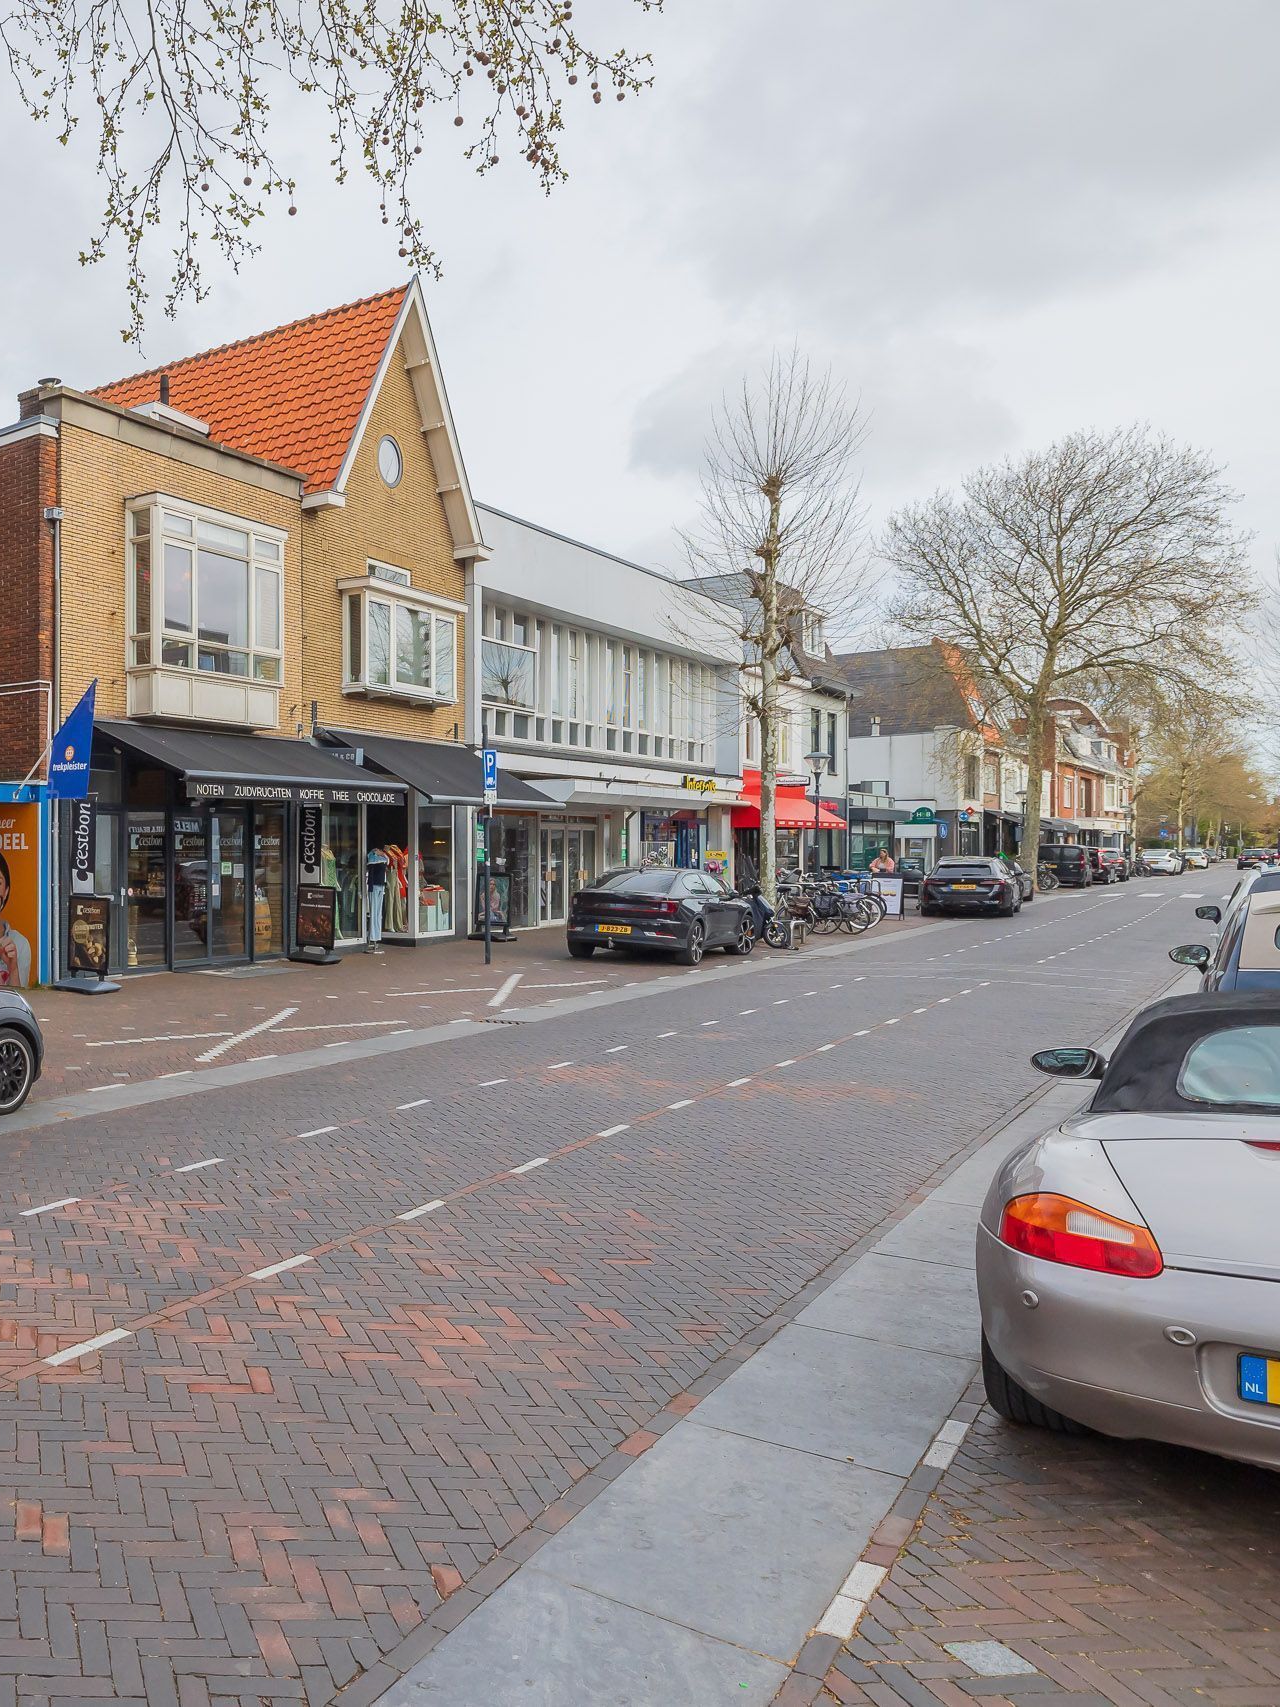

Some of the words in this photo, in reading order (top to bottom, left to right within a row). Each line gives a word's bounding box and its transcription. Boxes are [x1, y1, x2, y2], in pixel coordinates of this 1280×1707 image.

[52, 760, 88, 773] trekpleister
[196, 784, 224, 796] NOTEN
[234, 785, 292, 799] ZUIDVRUCHTEN
[299, 788, 325, 800] KOFFIE
[332, 790, 349, 801] THEE
[356, 791, 395, 803] CHOCOLADE
[1245, 1381, 1264, 1395] NL
